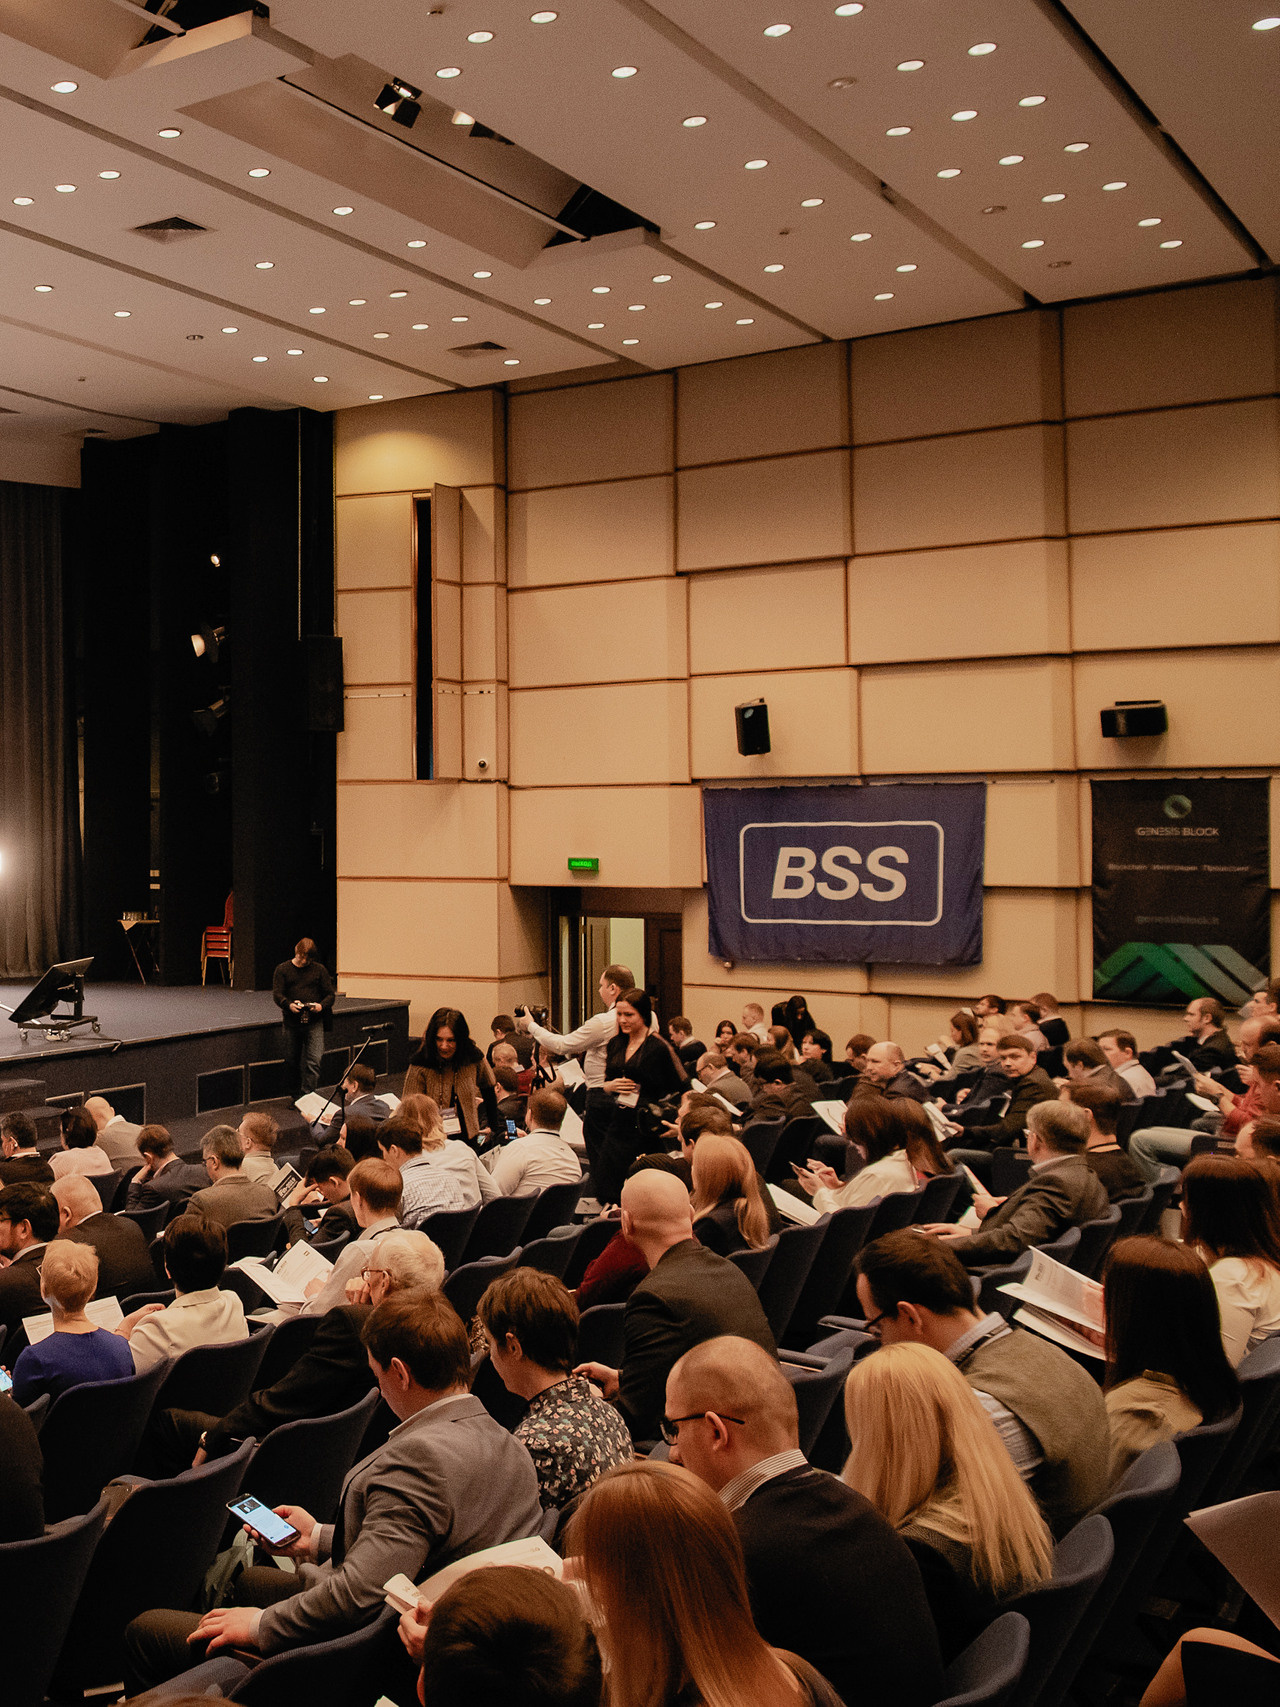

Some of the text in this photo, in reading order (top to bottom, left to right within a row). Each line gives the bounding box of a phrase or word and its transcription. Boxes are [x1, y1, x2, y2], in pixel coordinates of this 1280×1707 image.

[1136, 827, 1220, 837] GENESIS BLOCK
[772, 846, 909, 902] BSS
